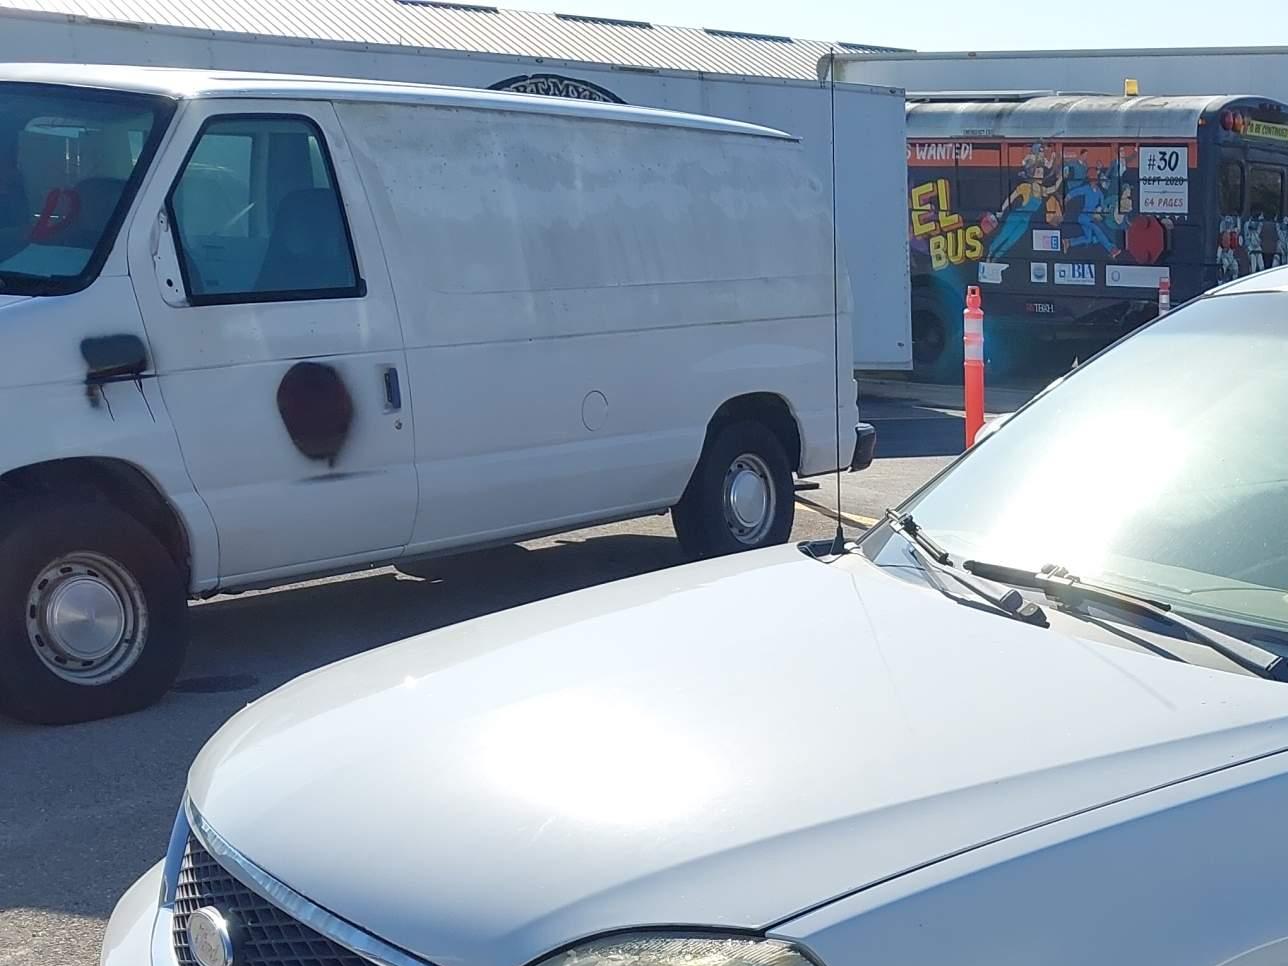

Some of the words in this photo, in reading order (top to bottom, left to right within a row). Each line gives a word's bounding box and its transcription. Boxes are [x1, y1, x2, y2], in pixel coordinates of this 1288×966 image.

[916, 143, 973, 160] WANTED!
[1147, 151, 1179, 171] #30
[1158, 198, 1183, 208] PAGES
[929, 225, 984, 271] BUS
